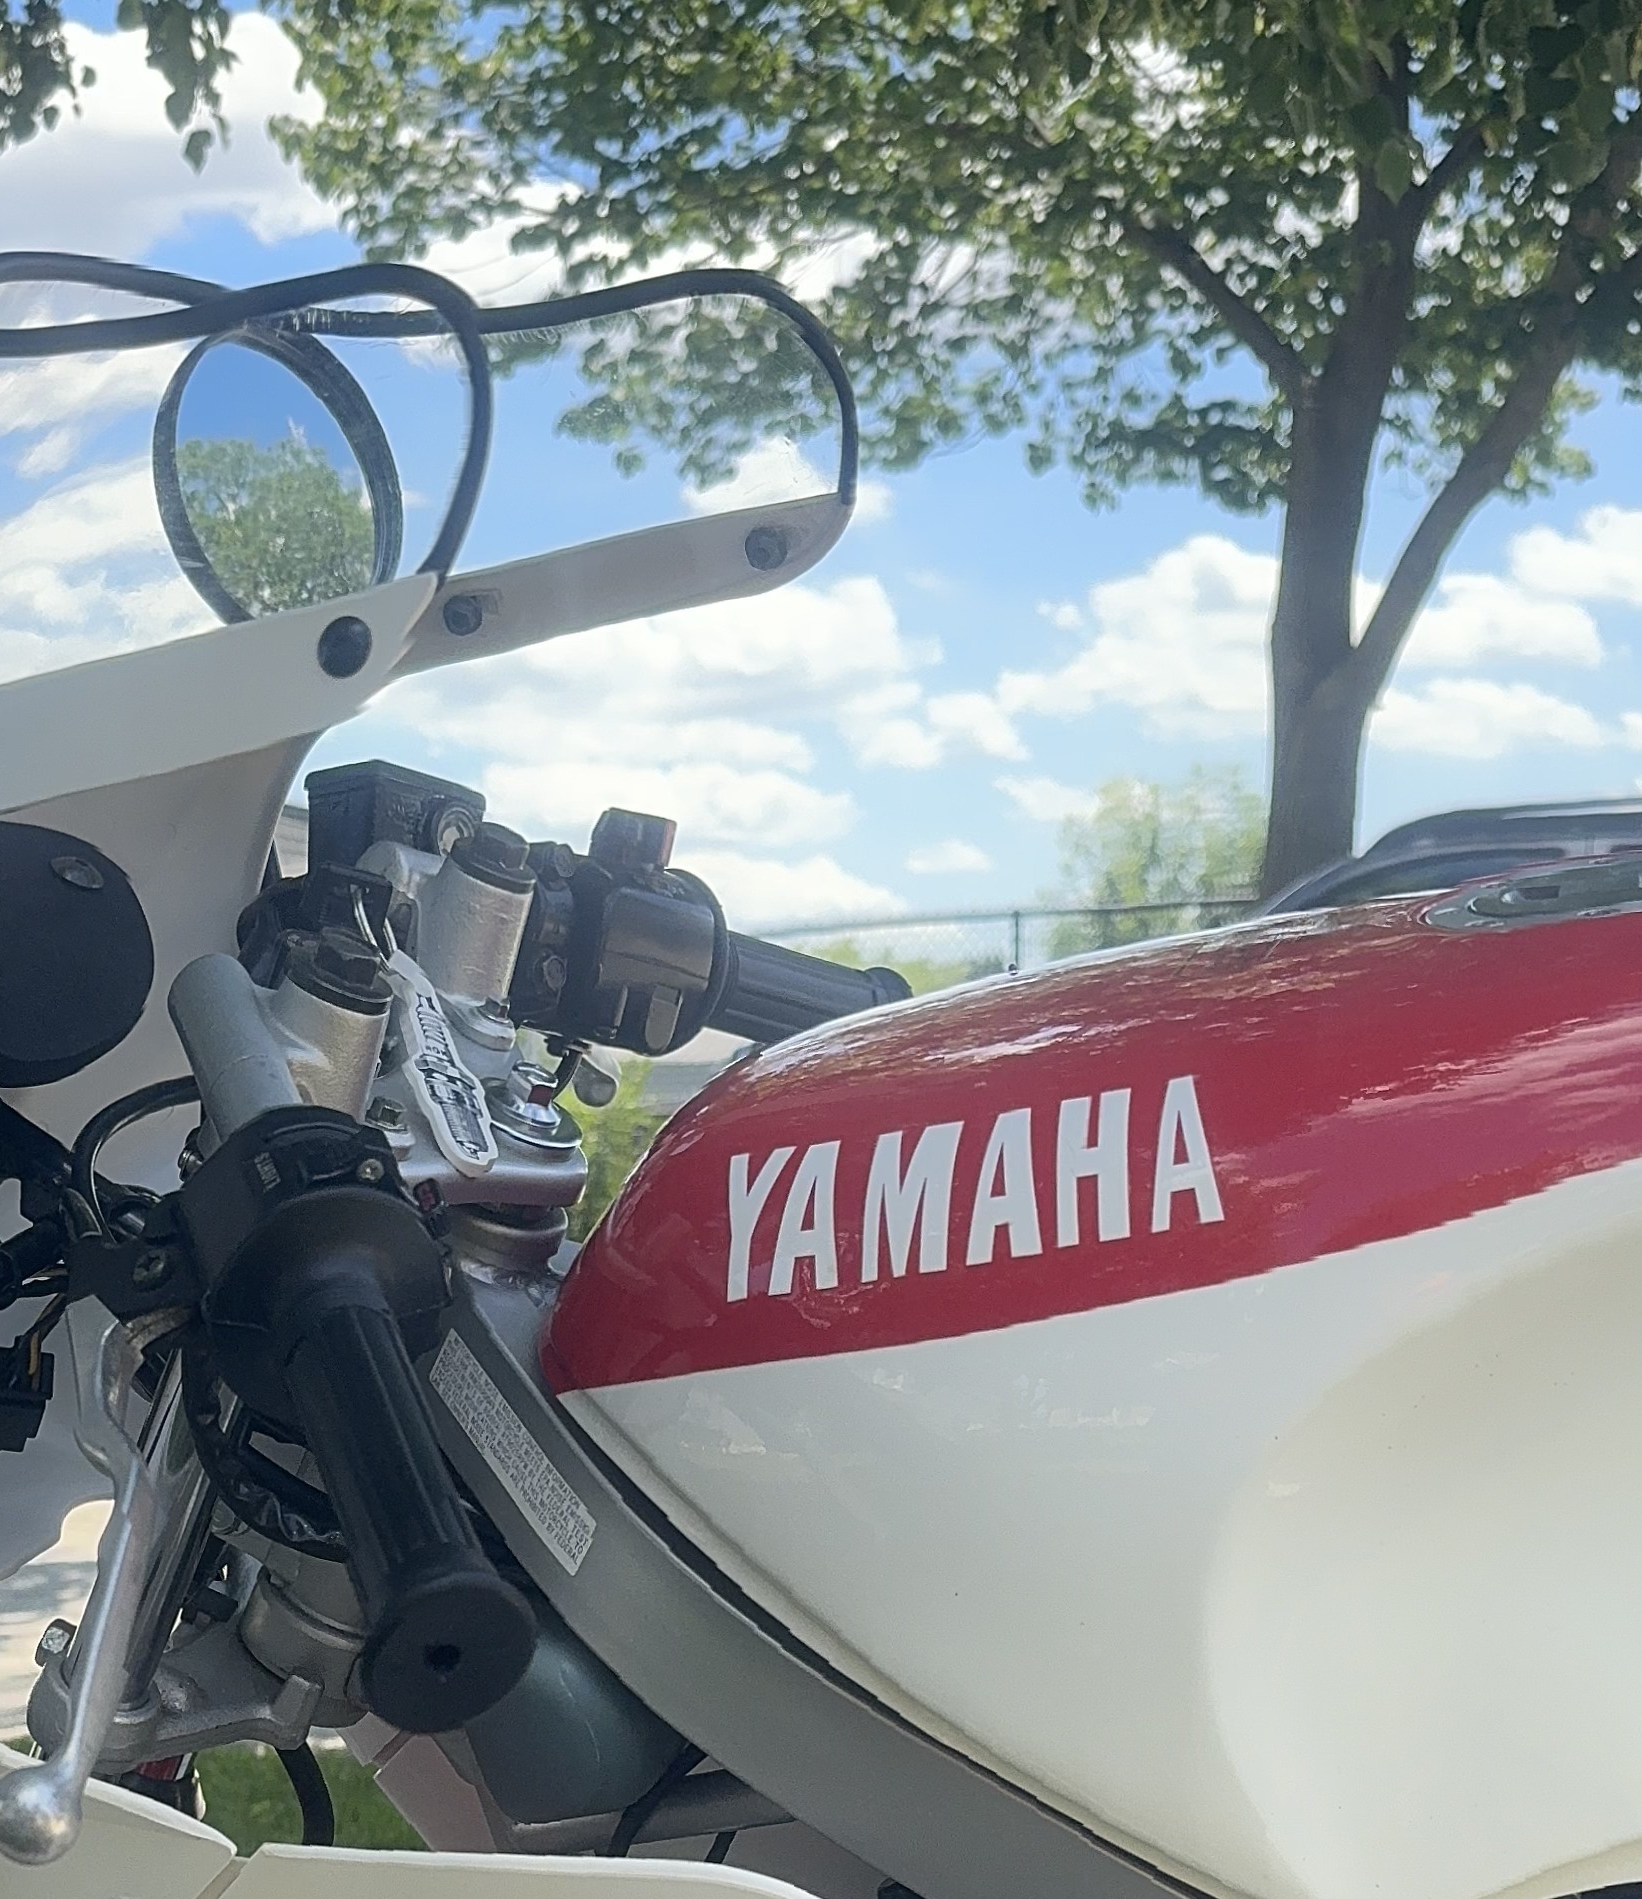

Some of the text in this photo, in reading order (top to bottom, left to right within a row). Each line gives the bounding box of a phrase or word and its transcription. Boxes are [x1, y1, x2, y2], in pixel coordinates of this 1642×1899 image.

[727, 1075, 1225, 1302] YAMAHA
[553, 1528, 579, 1568] FEDERAL
[570, 1521, 588, 1549] TEST
[573, 1539, 584, 1557] TO
